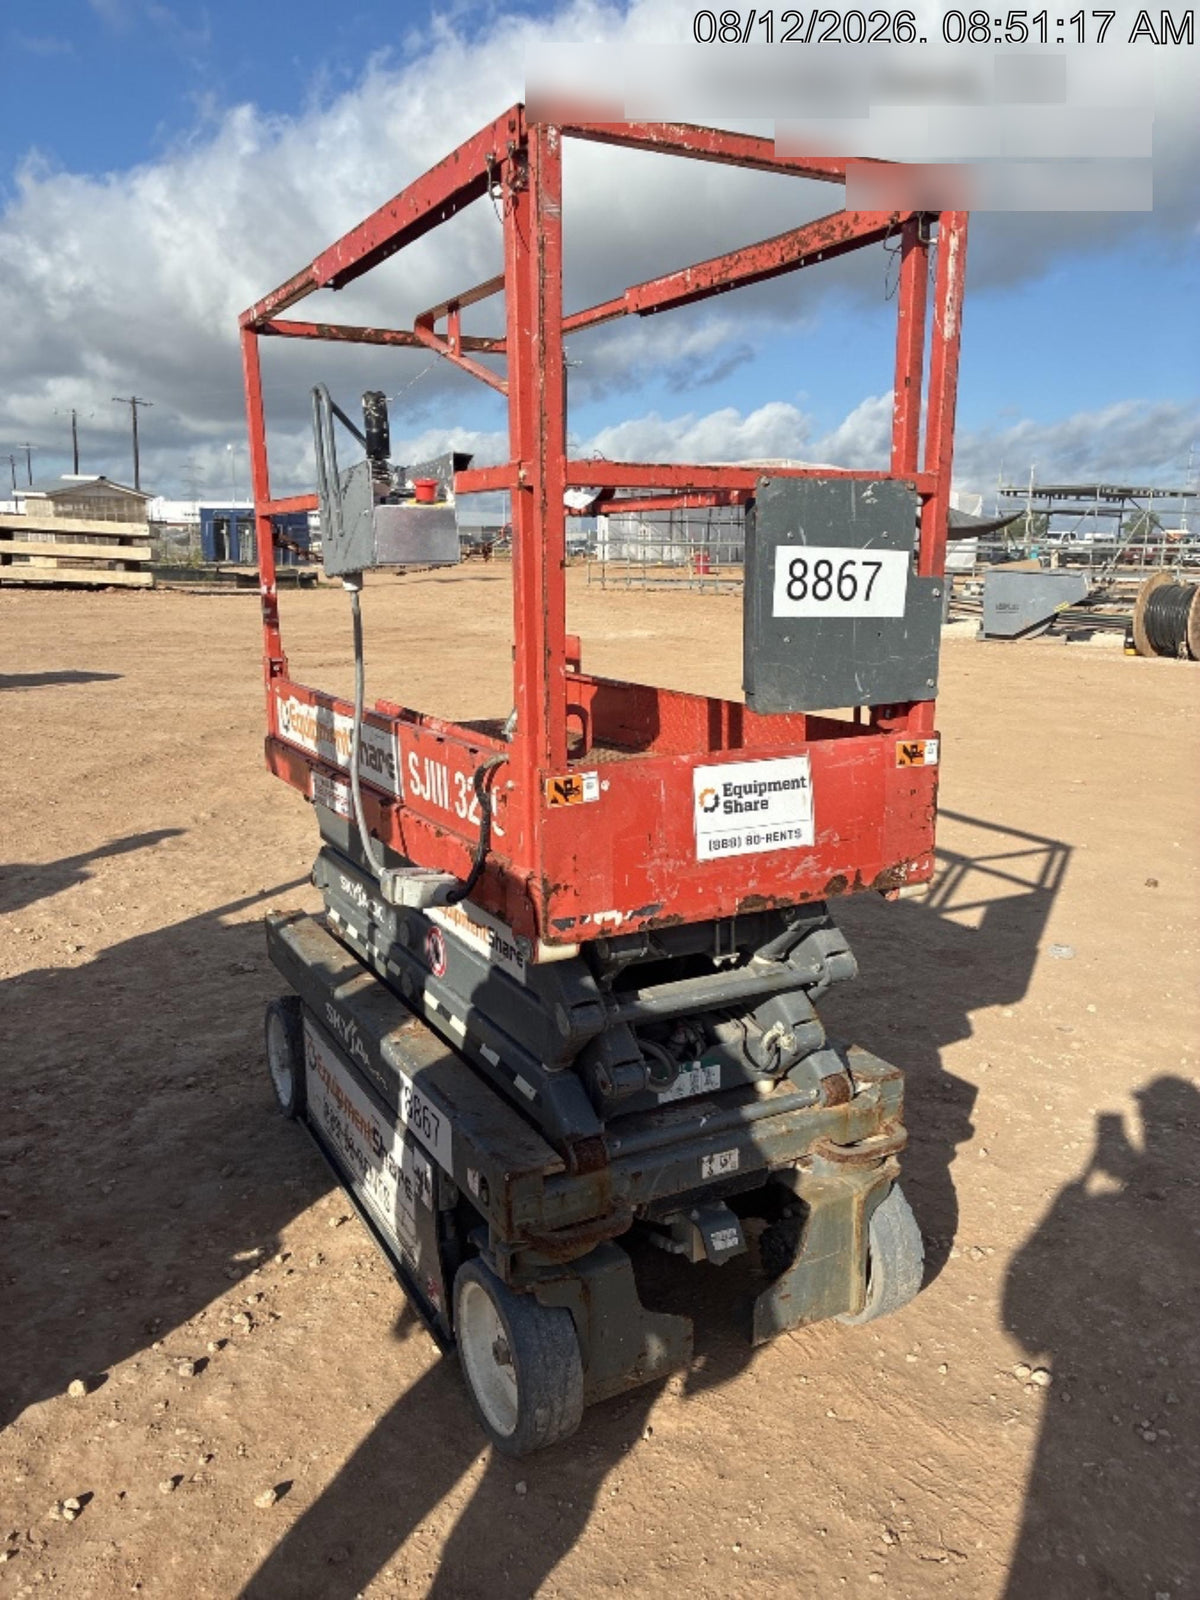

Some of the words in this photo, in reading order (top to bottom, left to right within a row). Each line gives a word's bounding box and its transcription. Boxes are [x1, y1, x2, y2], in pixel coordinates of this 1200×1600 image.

[786, 558, 883, 602] 8867
[721, 776, 808, 799] Equipment
[723, 799, 769, 815] Share
[708, 836, 742, 851] (888)
[745, 828, 802, 846] 80-RENTS
[404, 1086, 440, 1147] 8867
